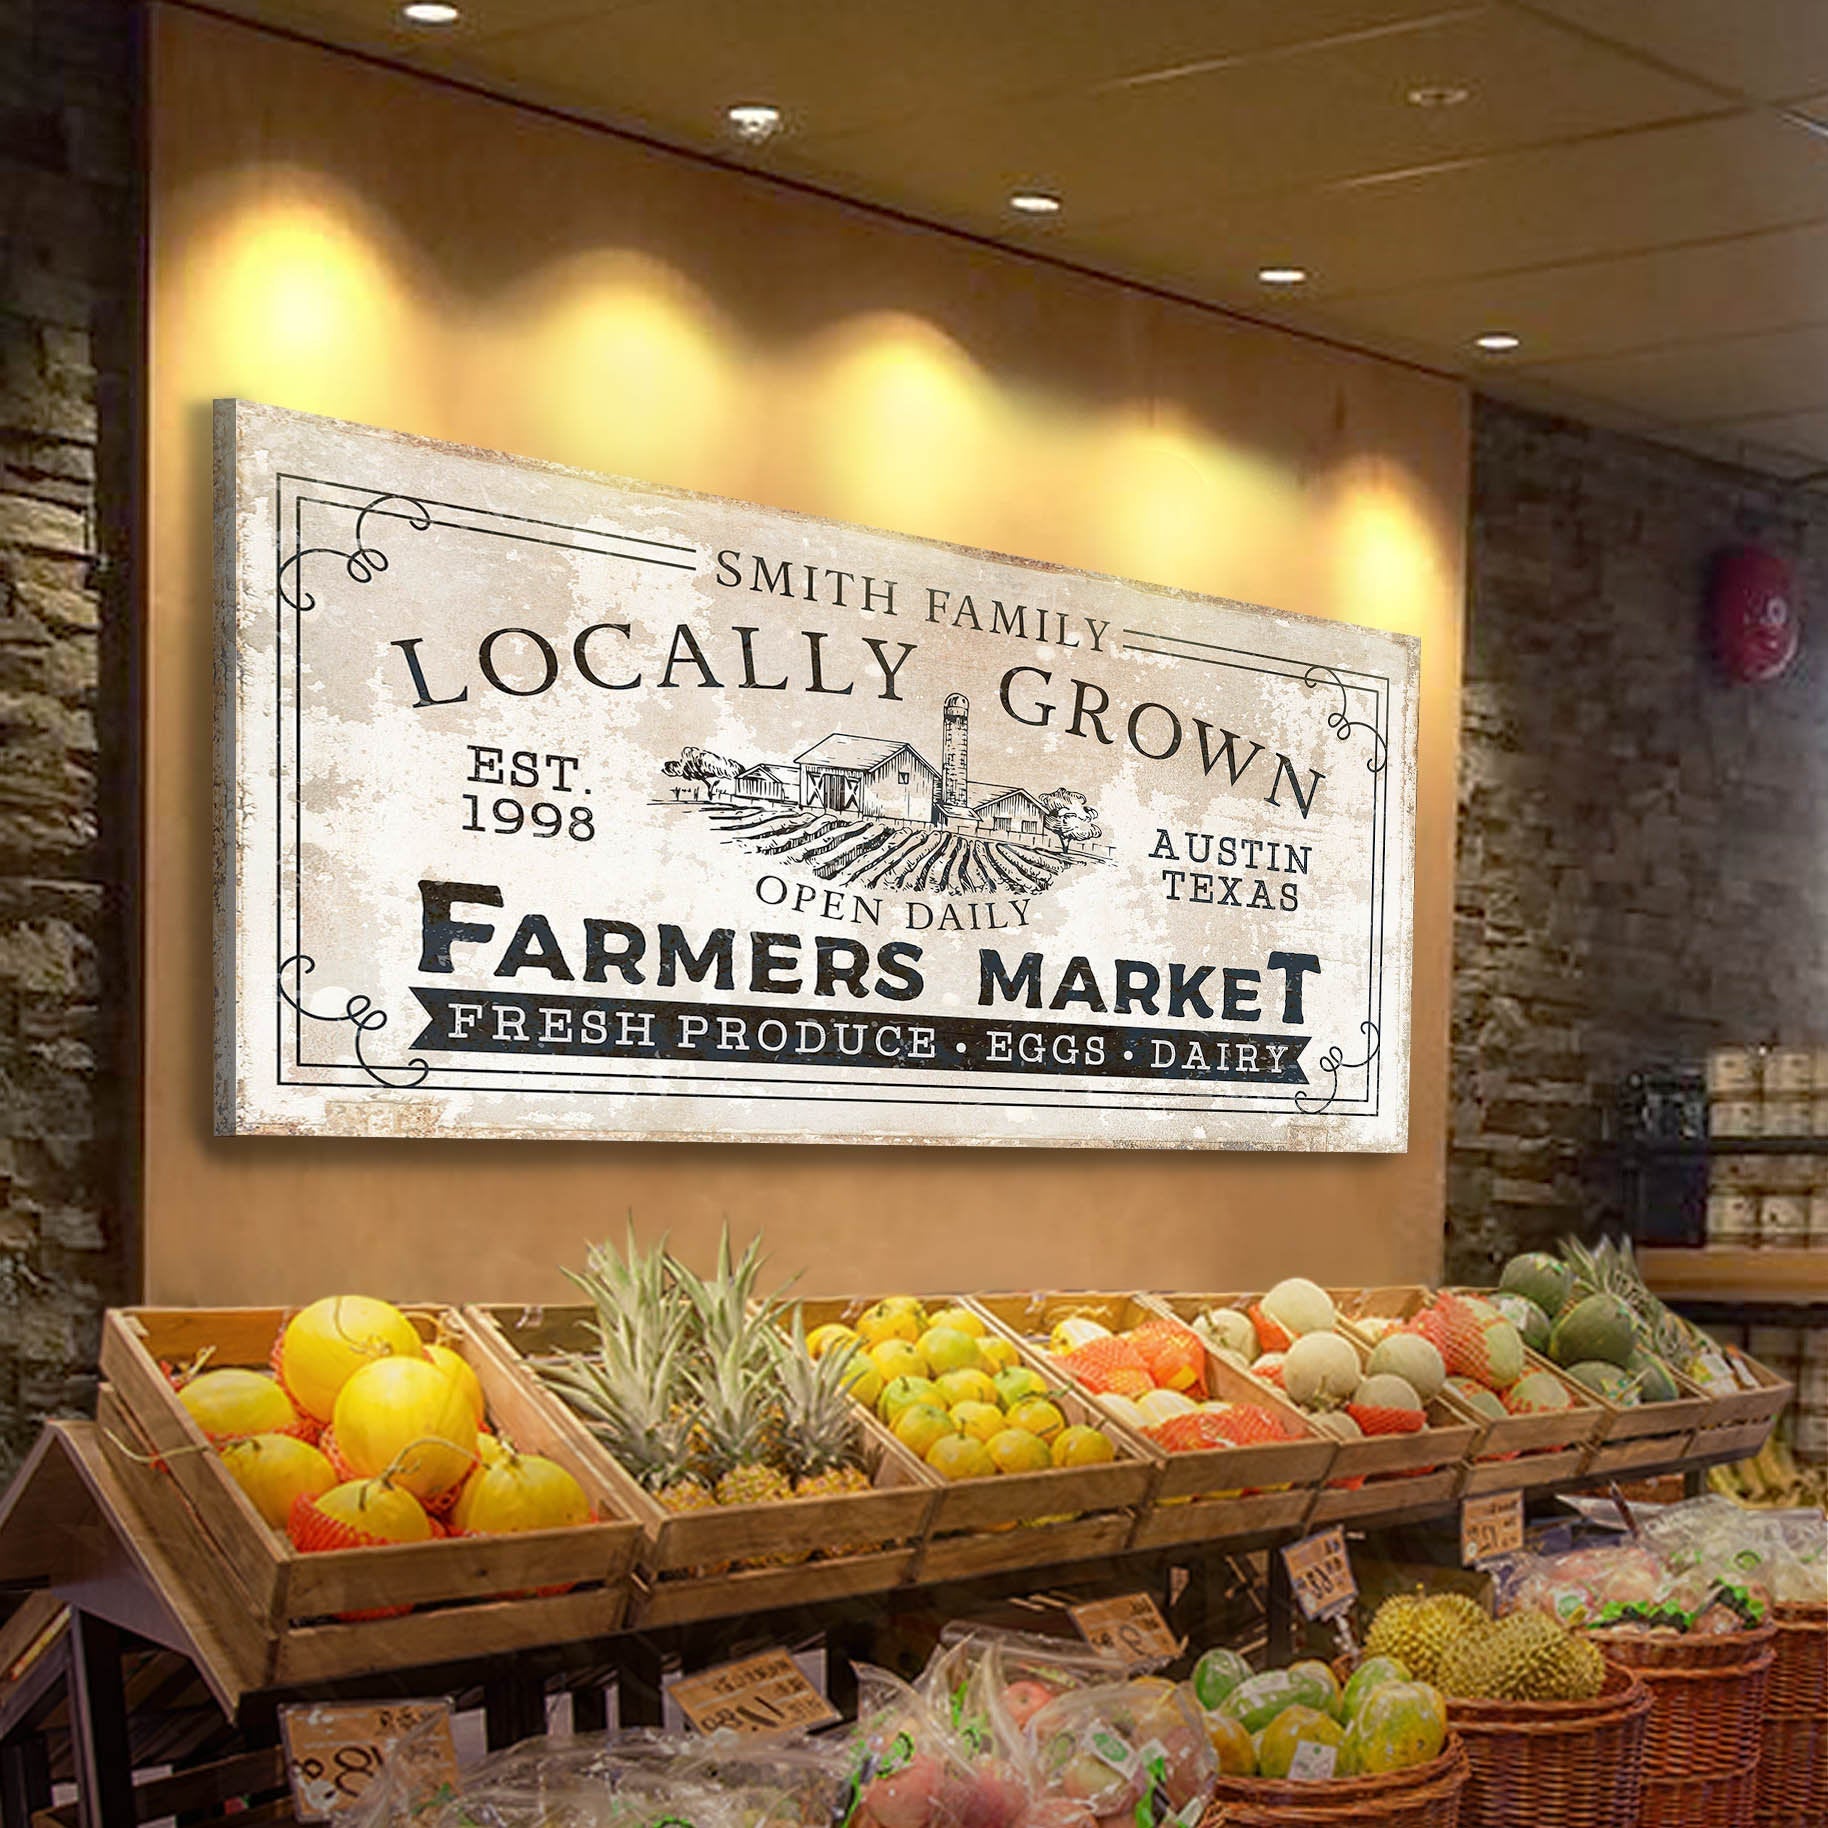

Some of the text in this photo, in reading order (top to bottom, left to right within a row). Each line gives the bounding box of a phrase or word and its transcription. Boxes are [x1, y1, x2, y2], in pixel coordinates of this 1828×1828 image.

[717, 550, 1110, 653] SMITH FAMILY
[390, 620, 1327, 821] LOCALLY GROWN
[463, 744, 592, 797] EST.
[462, 794, 595, 843] 1998
[1148, 828, 1313, 876] AUSTIN
[755, 875, 1032, 932] OPEN DAILY
[1162, 868, 1299, 912] TEXAS
[417, 879, 1322, 1026] FARMERS MARKET
[447, 1002, 1289, 1074] FRESH PRODUCE EGGS DAIRY
